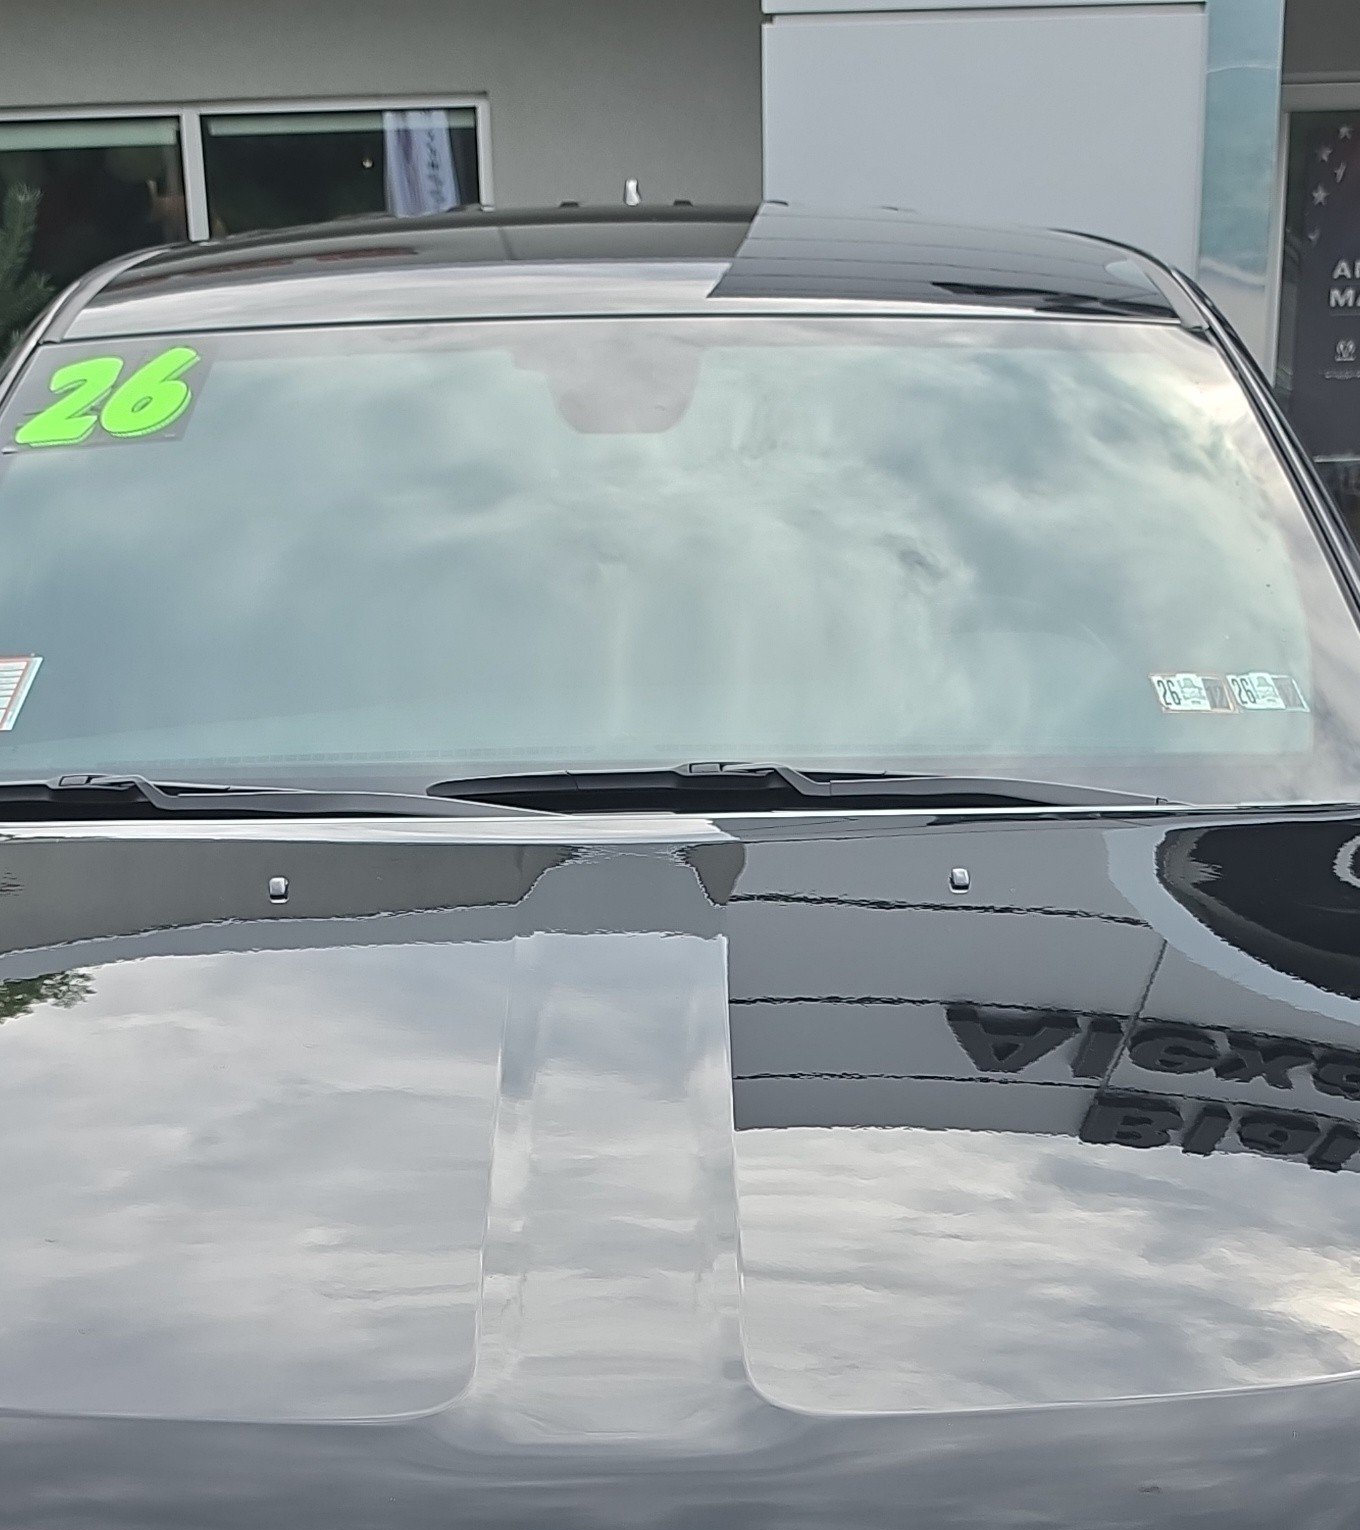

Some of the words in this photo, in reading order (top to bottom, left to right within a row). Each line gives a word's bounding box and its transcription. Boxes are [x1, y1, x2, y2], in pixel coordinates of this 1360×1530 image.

[14, 346, 202, 447] 26
[1157, 679, 1182, 706] 26
[1231, 678, 1256, 704] 26
